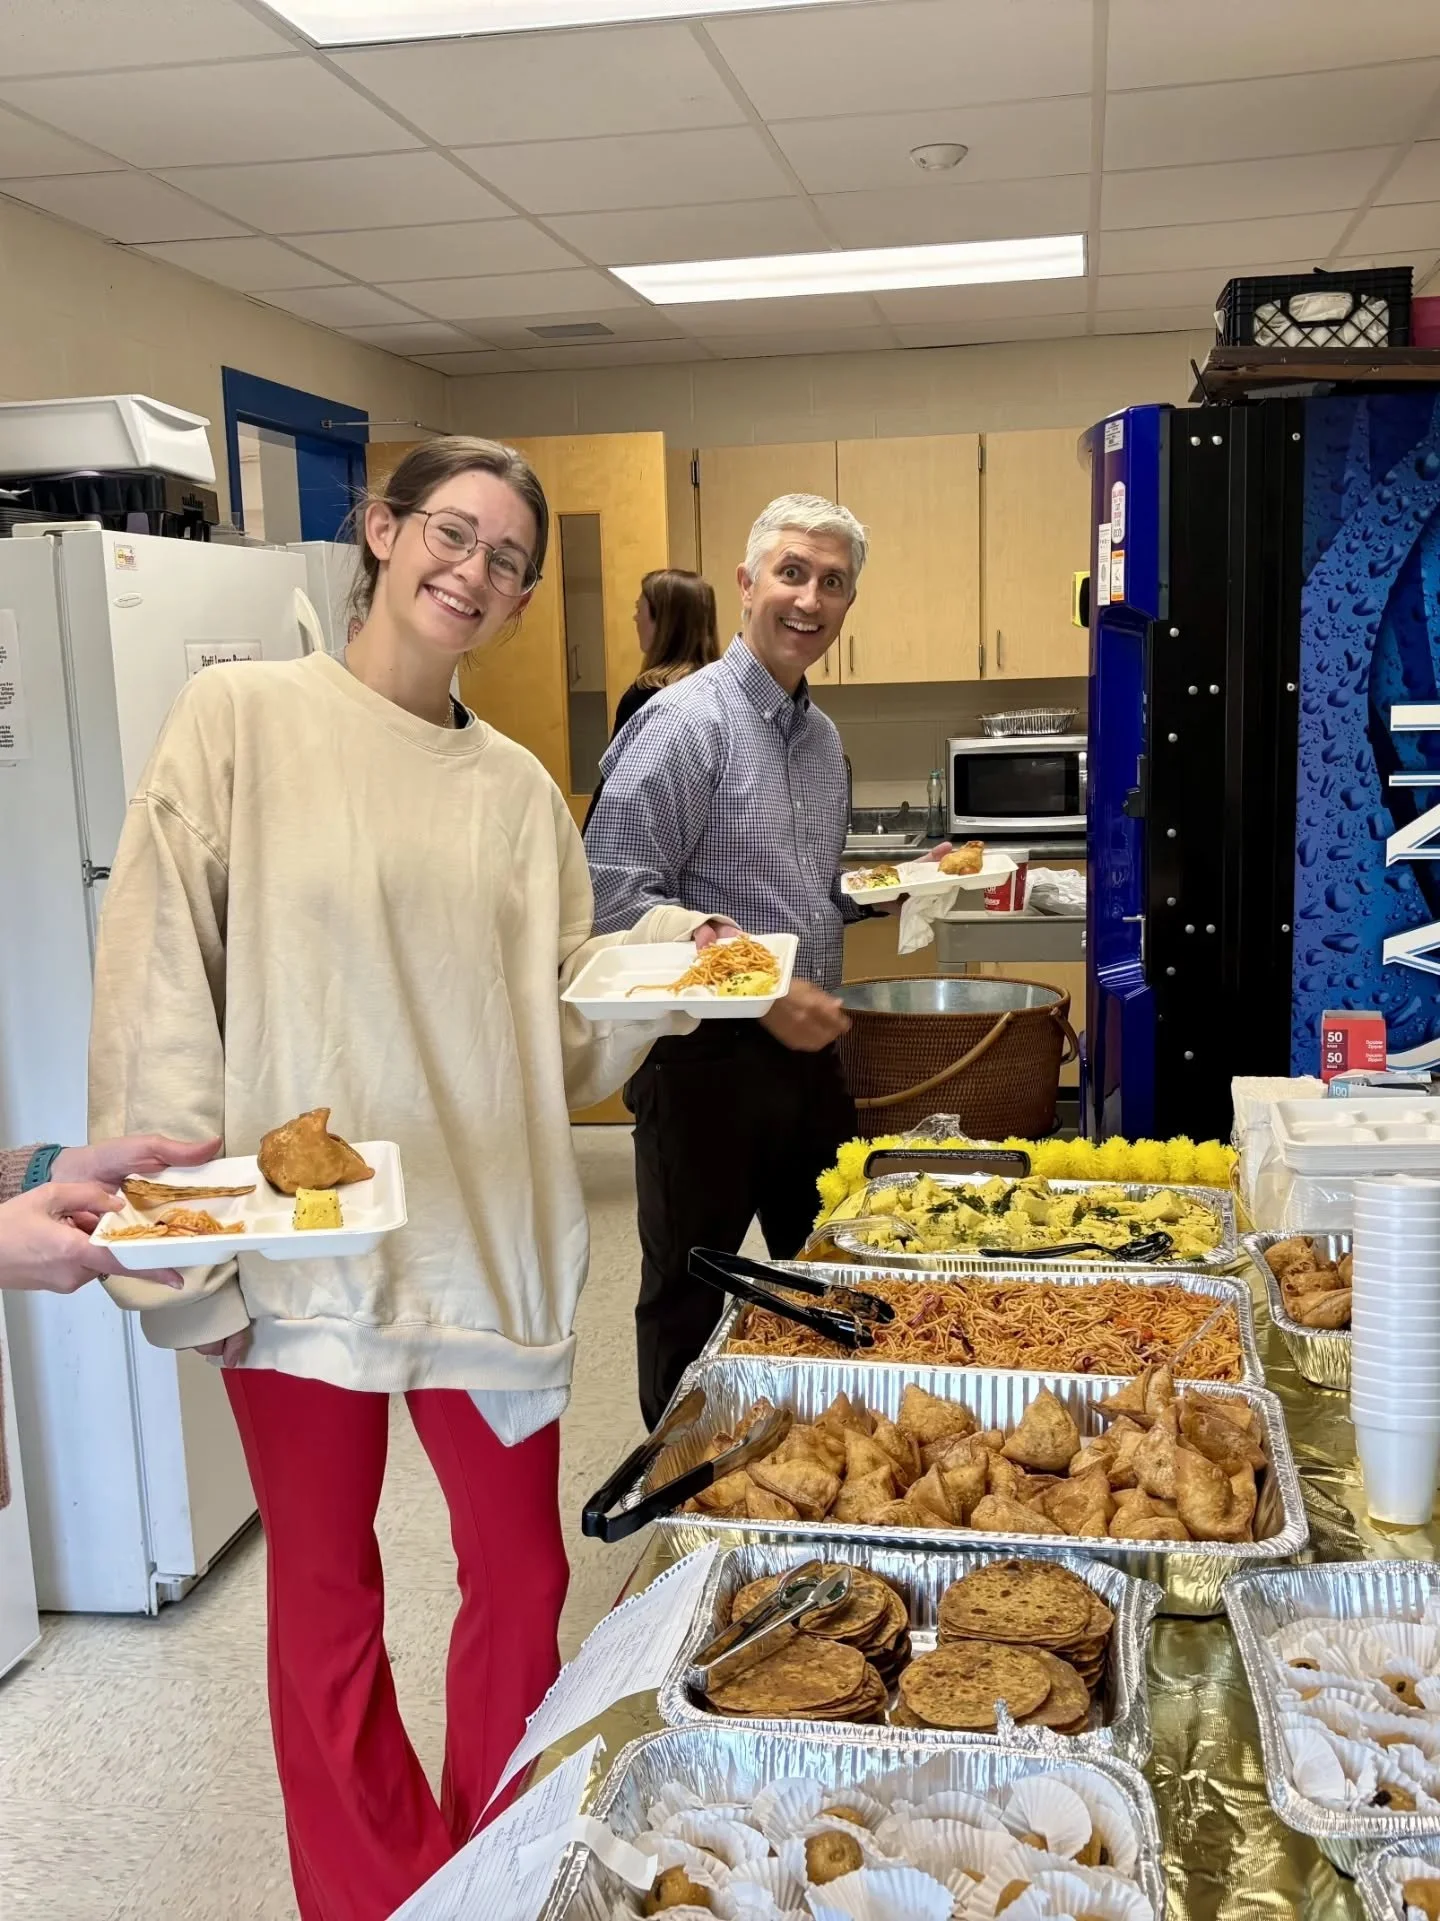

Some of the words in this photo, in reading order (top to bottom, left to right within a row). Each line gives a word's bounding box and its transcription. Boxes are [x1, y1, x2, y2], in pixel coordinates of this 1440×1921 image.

[1327, 1031, 1343, 1043] 50
[1327, 1052, 1343, 1063] 50
[1332, 1085, 1348, 1098] 100
